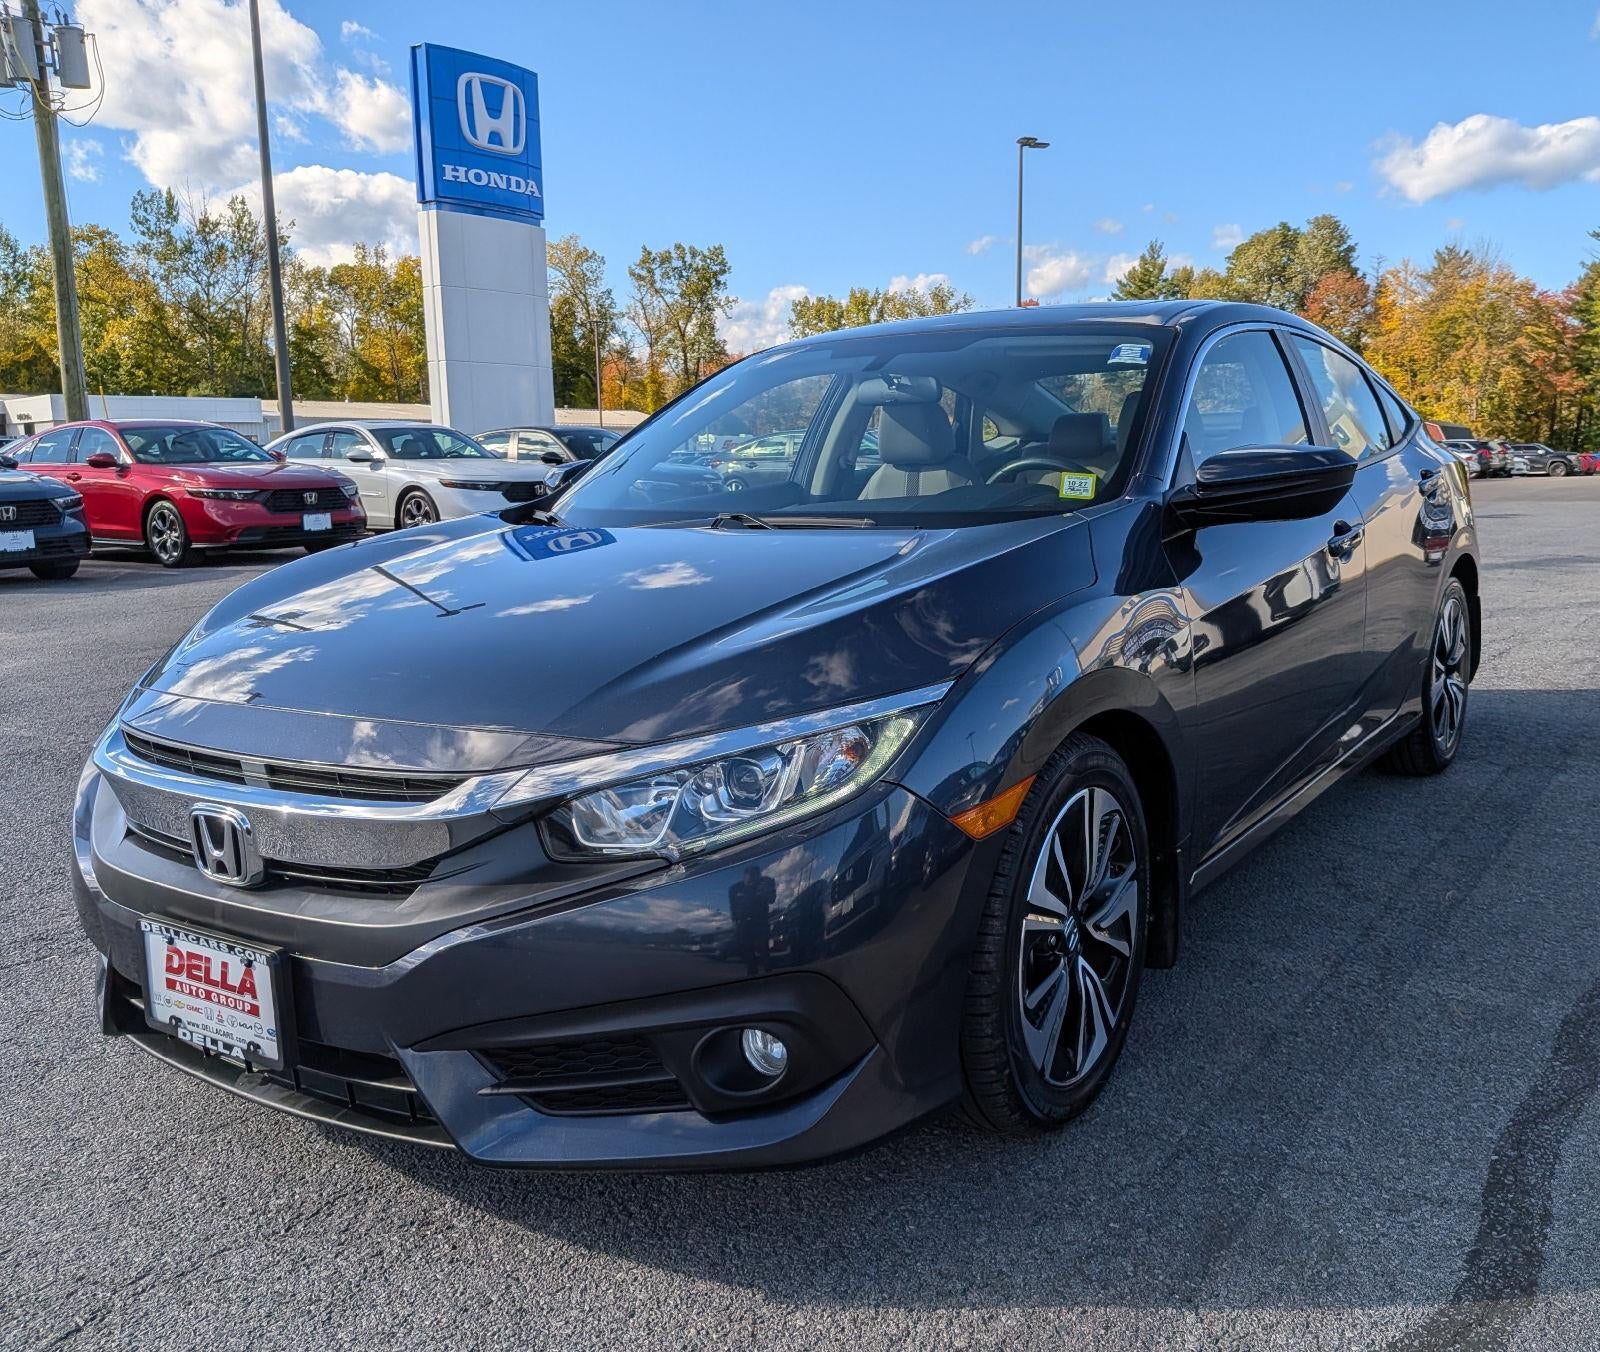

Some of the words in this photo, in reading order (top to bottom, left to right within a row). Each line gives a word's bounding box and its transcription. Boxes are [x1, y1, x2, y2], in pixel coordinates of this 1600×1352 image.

[442, 164, 542, 198] HONDA
[140, 920, 268, 966] DELLACARS.COM
[165, 945, 258, 1000] DELLA
[175, 981, 206, 999] AUTO
[211, 993, 252, 1013] GROUP
[186, 1003, 204, 1015] GMC
[177, 1027, 246, 1060] DELLA
